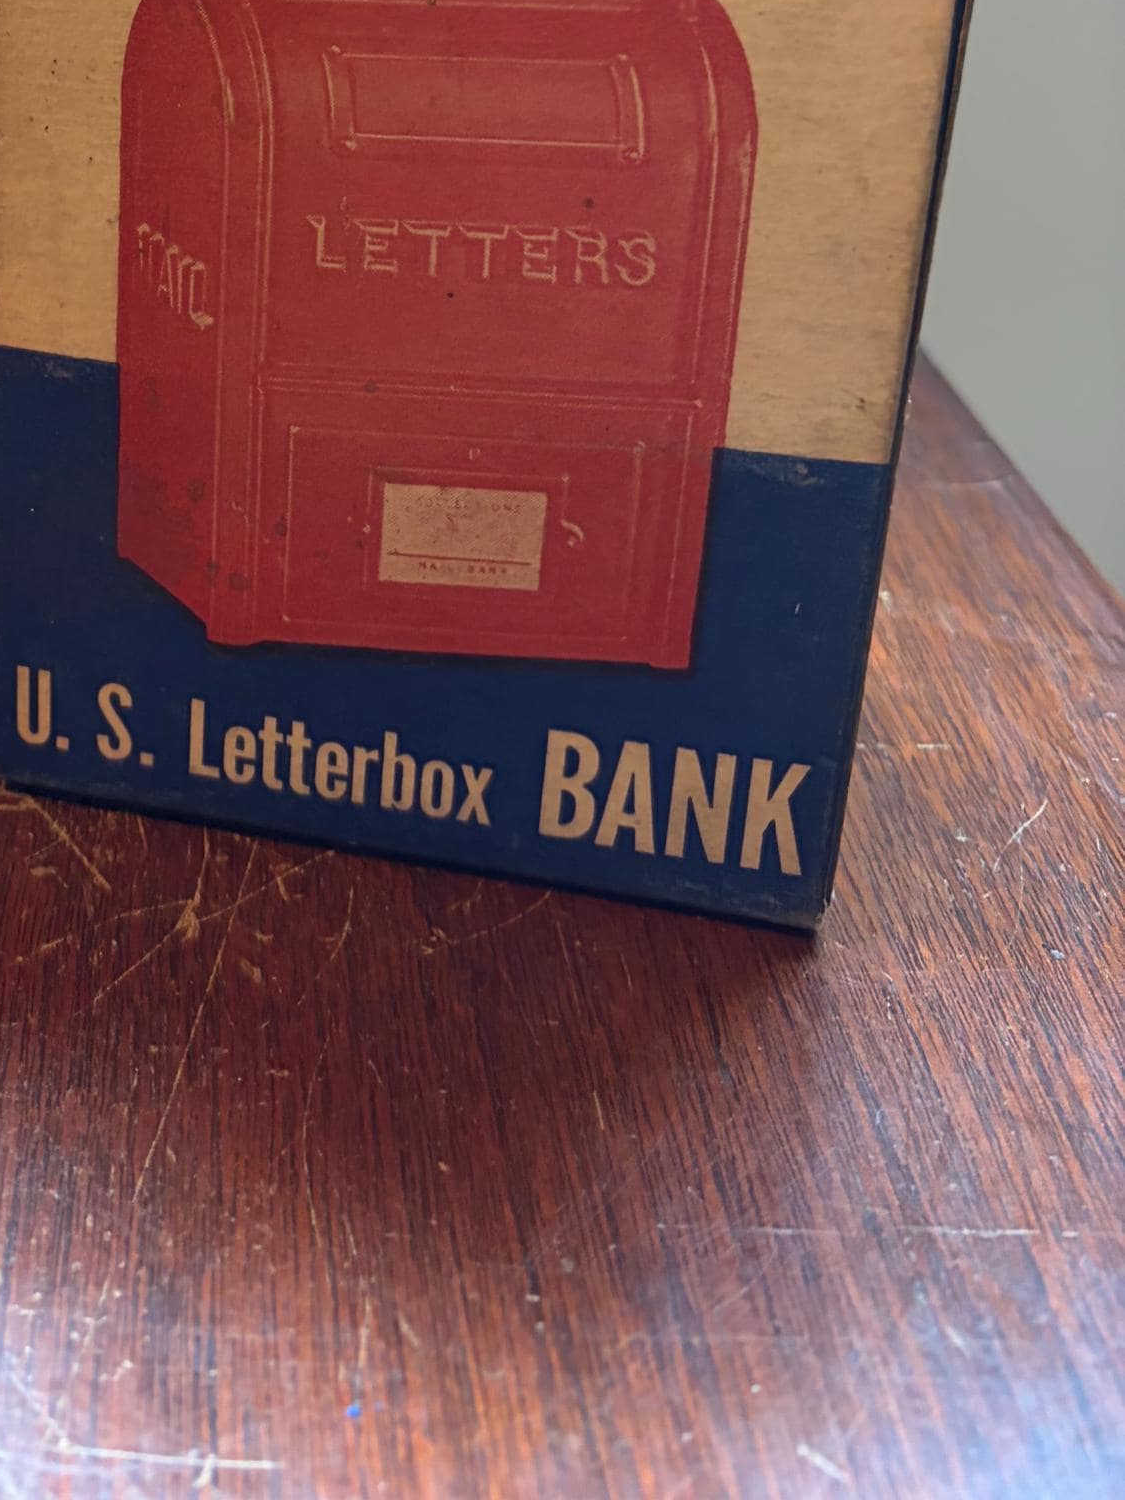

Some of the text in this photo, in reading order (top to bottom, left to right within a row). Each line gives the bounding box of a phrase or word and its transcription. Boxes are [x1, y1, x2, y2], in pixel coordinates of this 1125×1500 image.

[307, 214, 657, 288] LETTERS
[15, 664, 812, 877] U. S. Letterbox BANK
